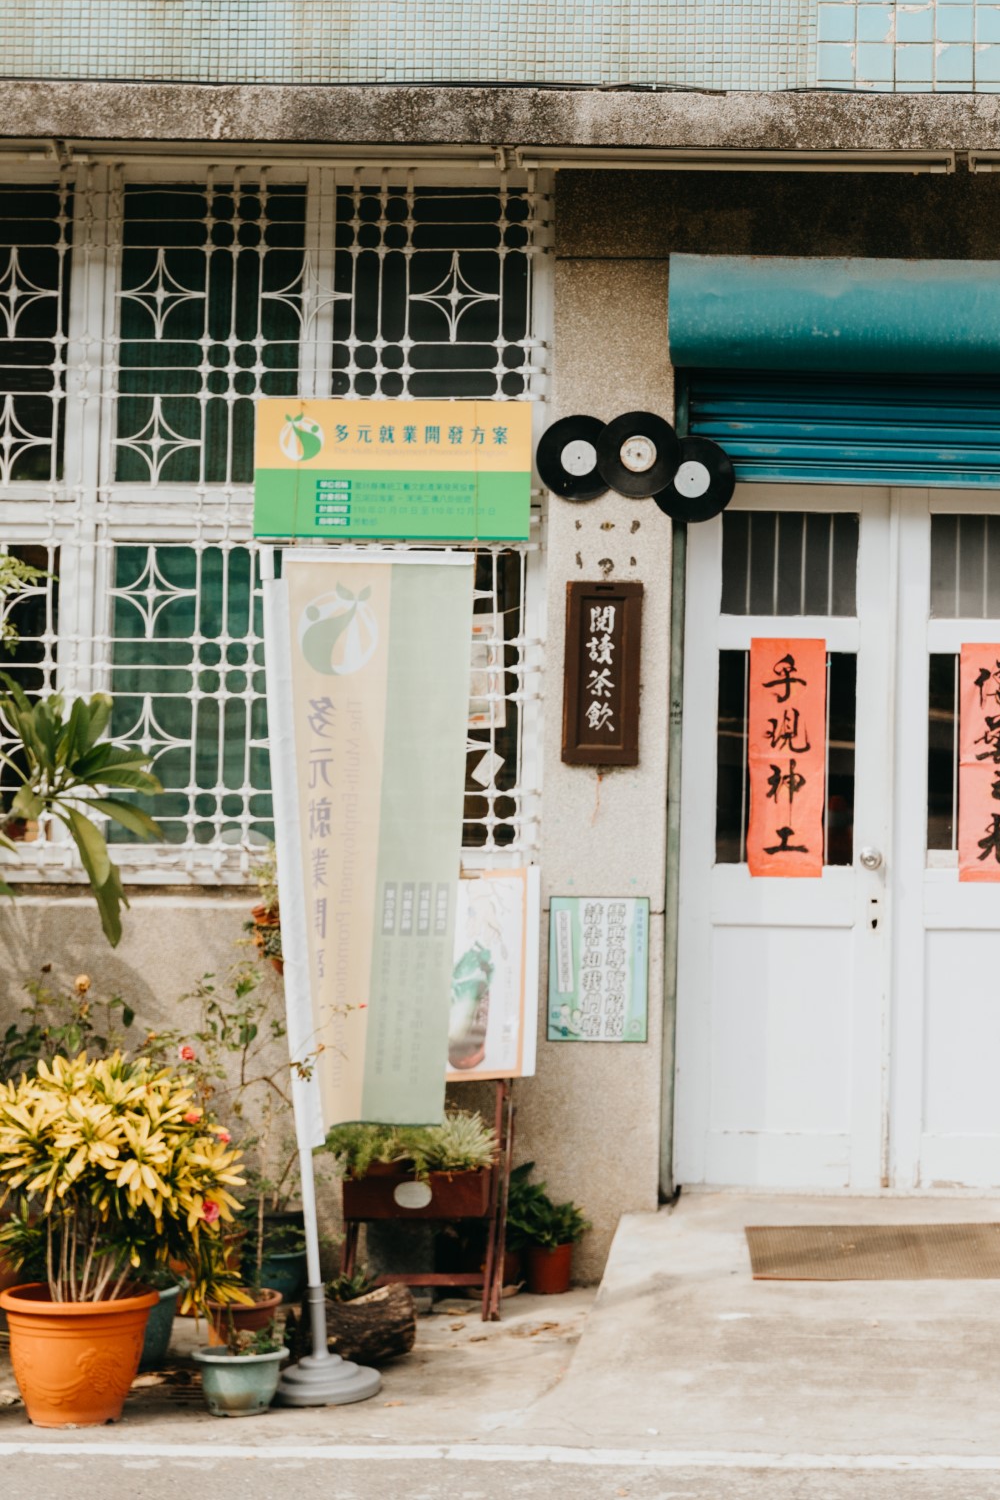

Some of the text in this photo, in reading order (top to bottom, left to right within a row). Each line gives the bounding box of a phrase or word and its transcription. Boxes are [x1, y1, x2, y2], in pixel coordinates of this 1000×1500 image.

[334, 424, 509, 445] 多元就業開發方案
[585, 605, 617, 732] 閱讀茶飲
[604, 902, 627, 1037] 需要導覽解說
